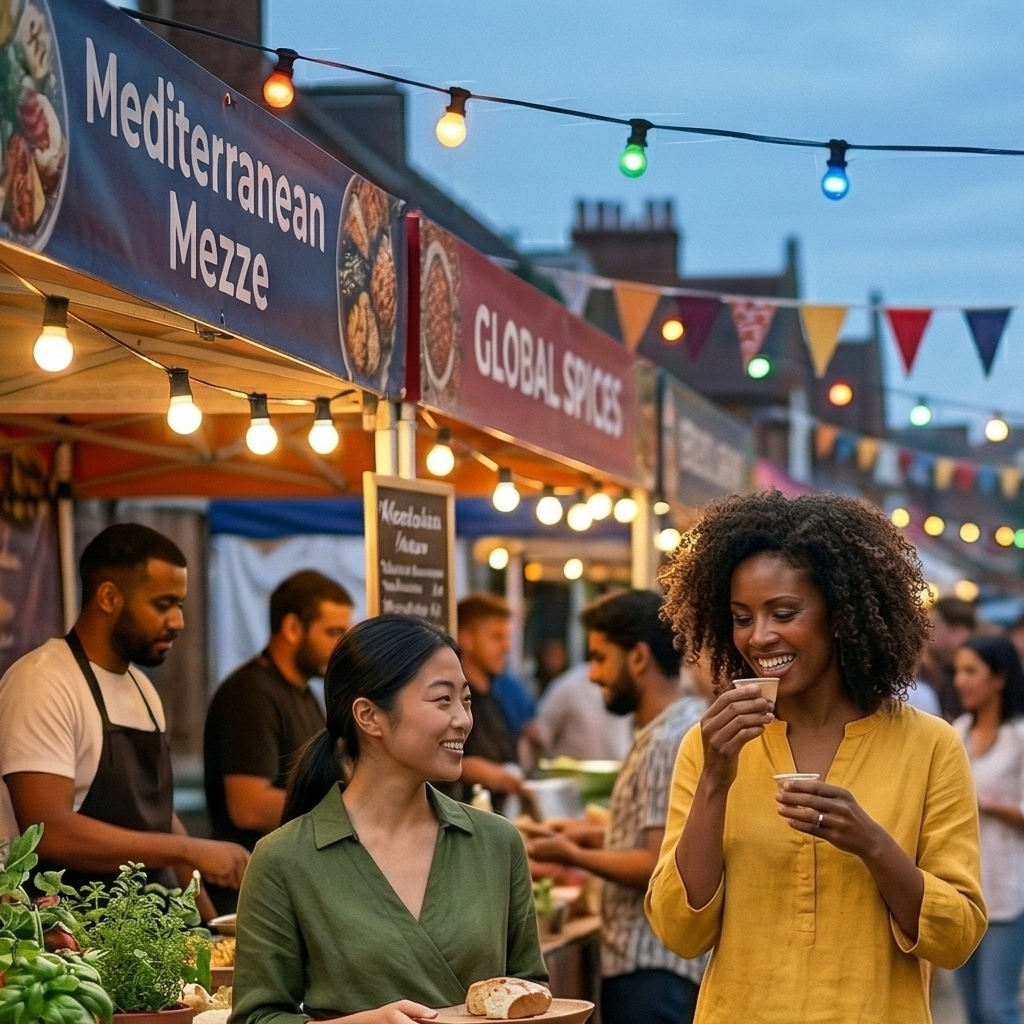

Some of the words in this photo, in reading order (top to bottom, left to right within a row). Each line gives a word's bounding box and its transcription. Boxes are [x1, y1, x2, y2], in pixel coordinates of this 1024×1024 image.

[86, 37, 325, 253] Mediterranean
[169, 190, 269, 311] Mezze
[474, 303, 561, 410] GLOBAL
[562, 350, 623, 438] SPICES
